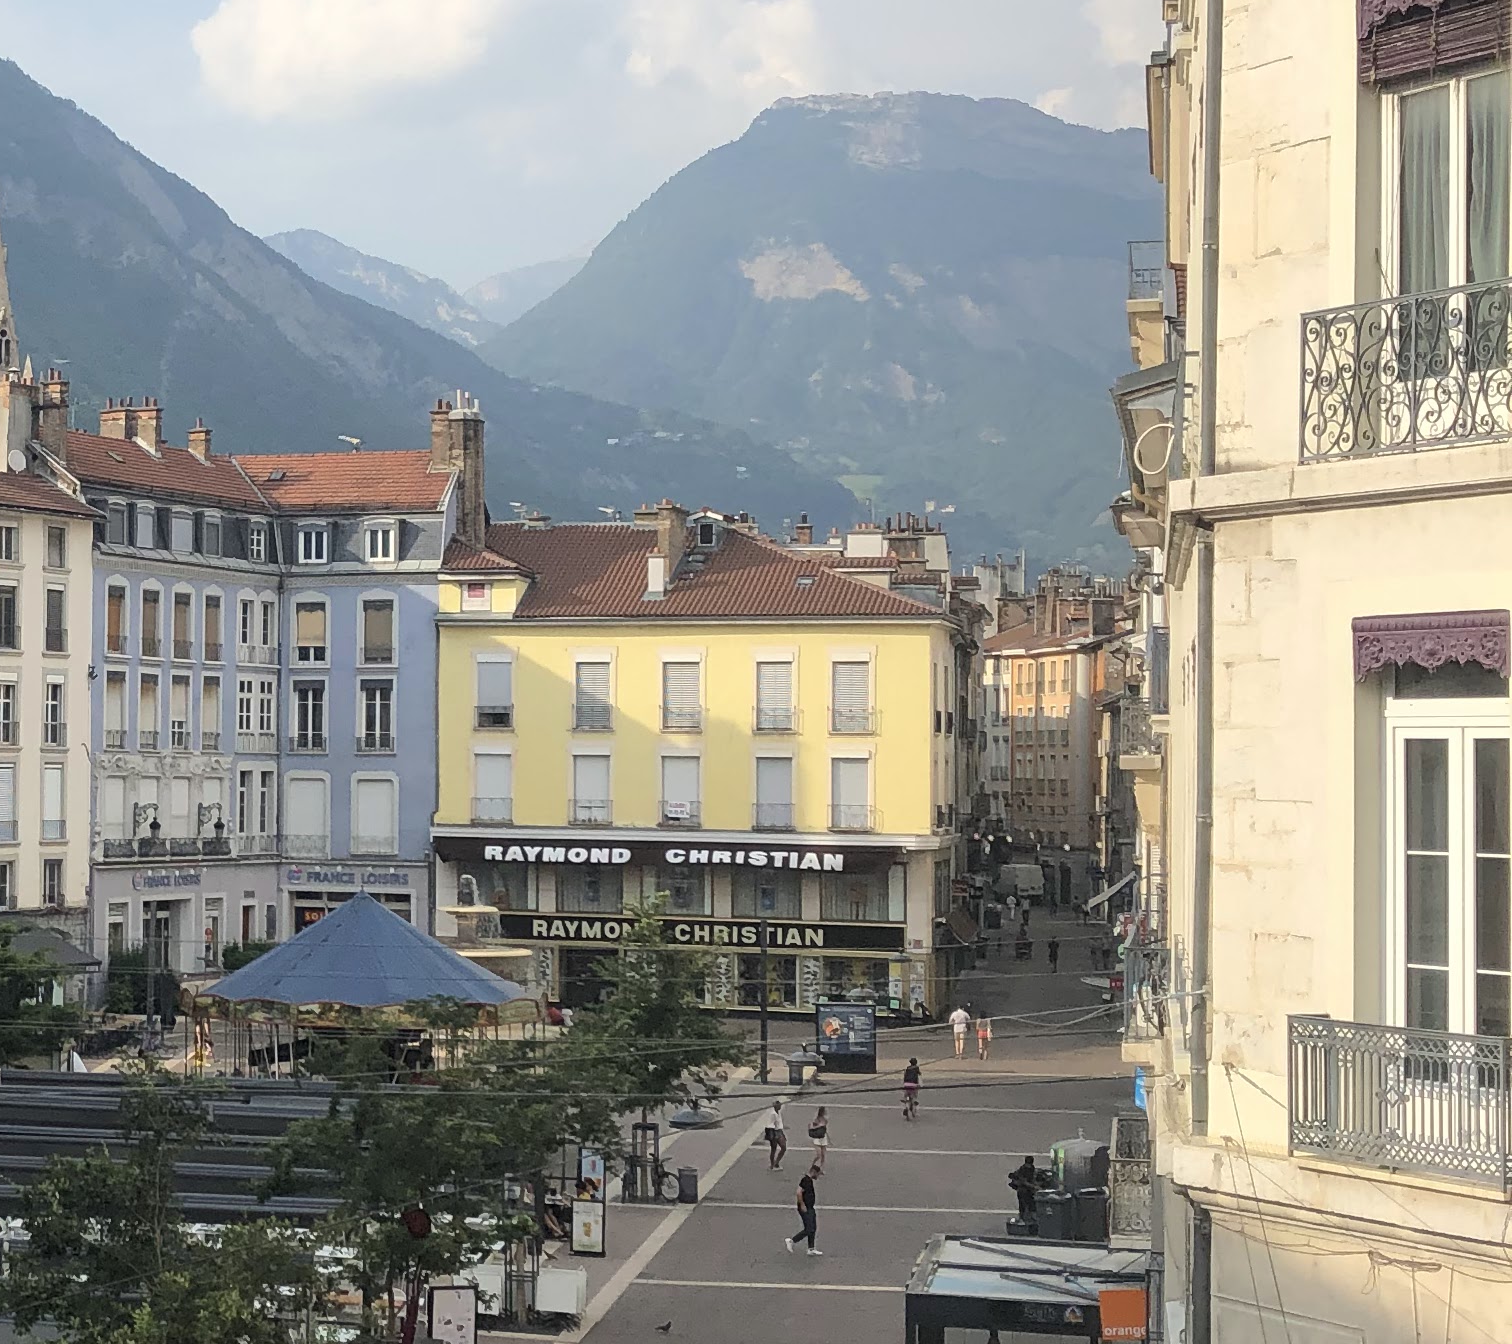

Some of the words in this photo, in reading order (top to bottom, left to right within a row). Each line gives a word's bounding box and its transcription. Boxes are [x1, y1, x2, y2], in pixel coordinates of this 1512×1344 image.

[484, 845, 632, 864] RAYMOND
[665, 848, 844, 872] CHRISTIAN
[306, 871, 355, 885] FRANCE
[361, 872, 409, 886] LOISIRS
[532, 919, 640, 940] RAYMON
[1104, 1326, 1147, 1338] orange
